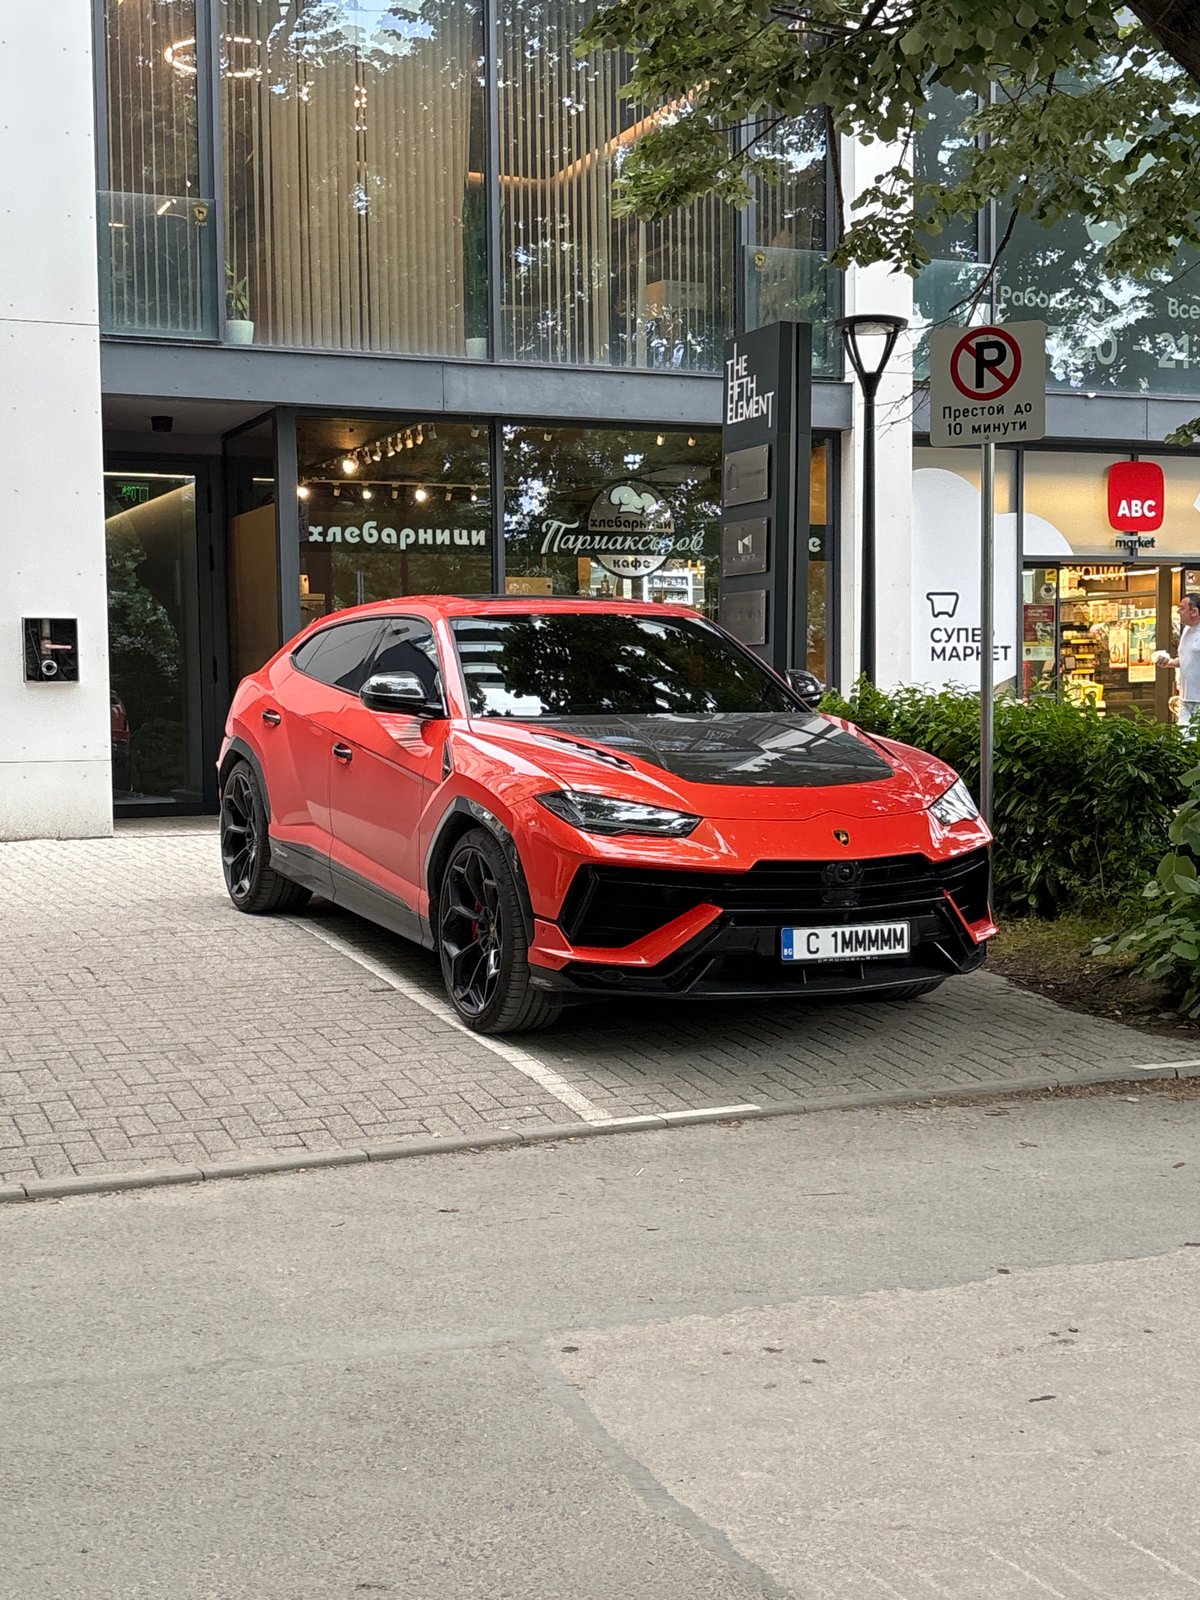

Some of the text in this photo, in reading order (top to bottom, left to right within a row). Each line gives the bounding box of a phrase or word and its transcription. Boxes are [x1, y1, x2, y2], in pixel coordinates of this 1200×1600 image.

[726, 343, 748, 377] THE
[727, 374, 757, 401] FIFTH
[727, 391, 775, 428] ELEMENT
[942, 402, 1032, 421] Престой до
[947, 420, 1027, 436] 10 минути
[1117, 499, 1157, 518] ABC
[308, 520, 486, 550] хлебарници
[1115, 536, 1156, 549] market
[612, 557, 651, 570] кафе
[930, 627, 995, 643] СУПЕ
[806, 927, 905, 954] C 1MMMMM
